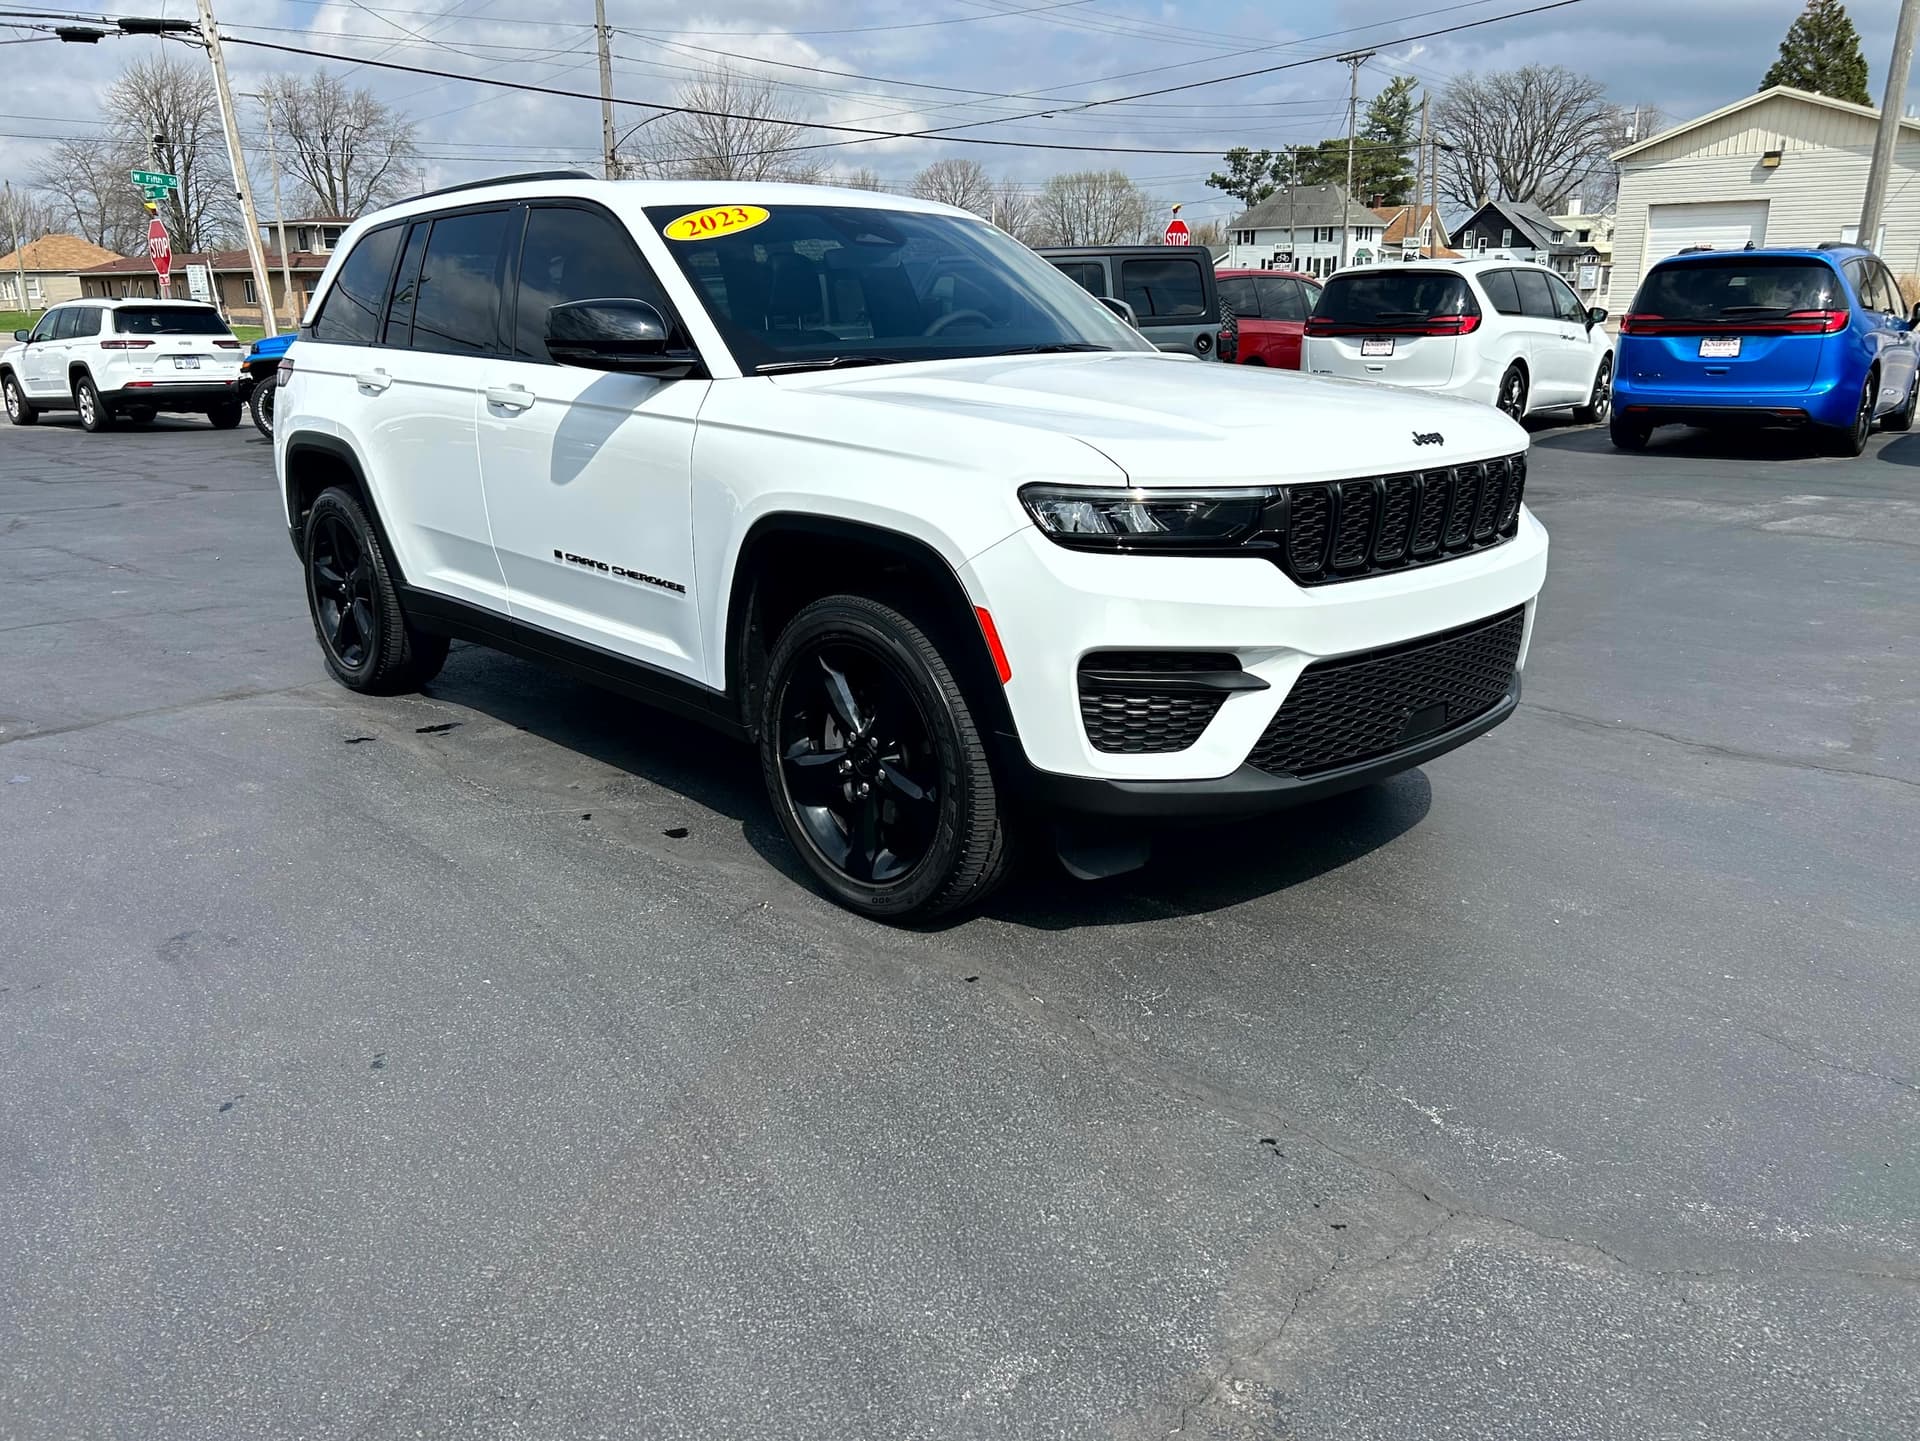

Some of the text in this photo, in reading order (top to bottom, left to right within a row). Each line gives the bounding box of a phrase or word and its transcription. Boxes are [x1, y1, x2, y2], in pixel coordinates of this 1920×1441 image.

[133, 173, 177, 186] W Fifth St
[682, 208, 749, 237] 2023
[150, 237, 168, 259] STOP
[1166, 232, 1188, 246] STOP
[1411, 431, 1444, 446] Jeep
[565, 553, 686, 593] GRAND CHEROKEE
